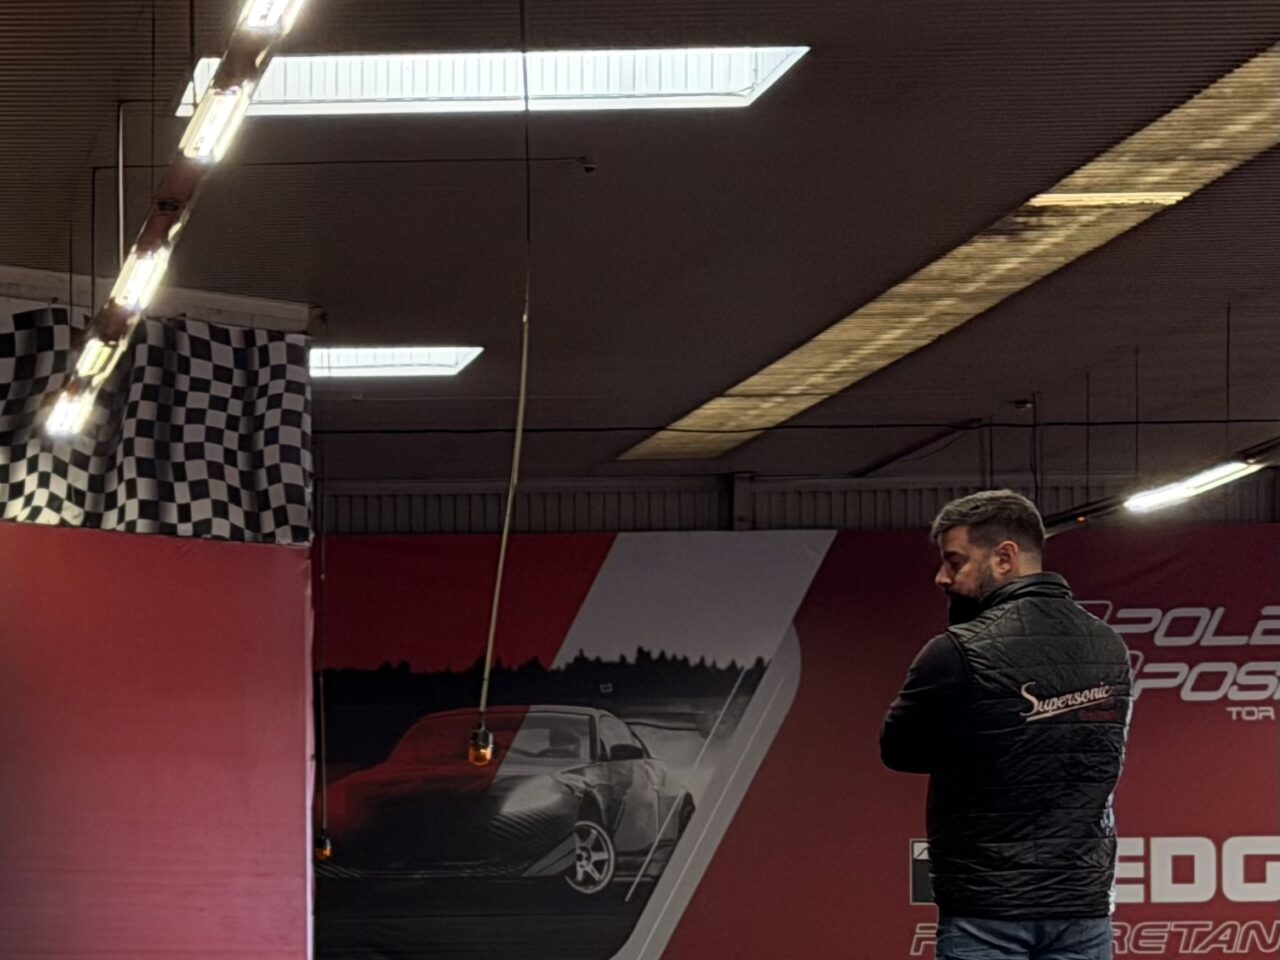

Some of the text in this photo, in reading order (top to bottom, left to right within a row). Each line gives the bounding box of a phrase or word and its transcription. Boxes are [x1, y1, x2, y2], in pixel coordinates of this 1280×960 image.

[1019, 681, 1112, 720] Supersonic
[1130, 661, 1280, 701] POS
[1225, 706, 1276, 721] TOR
